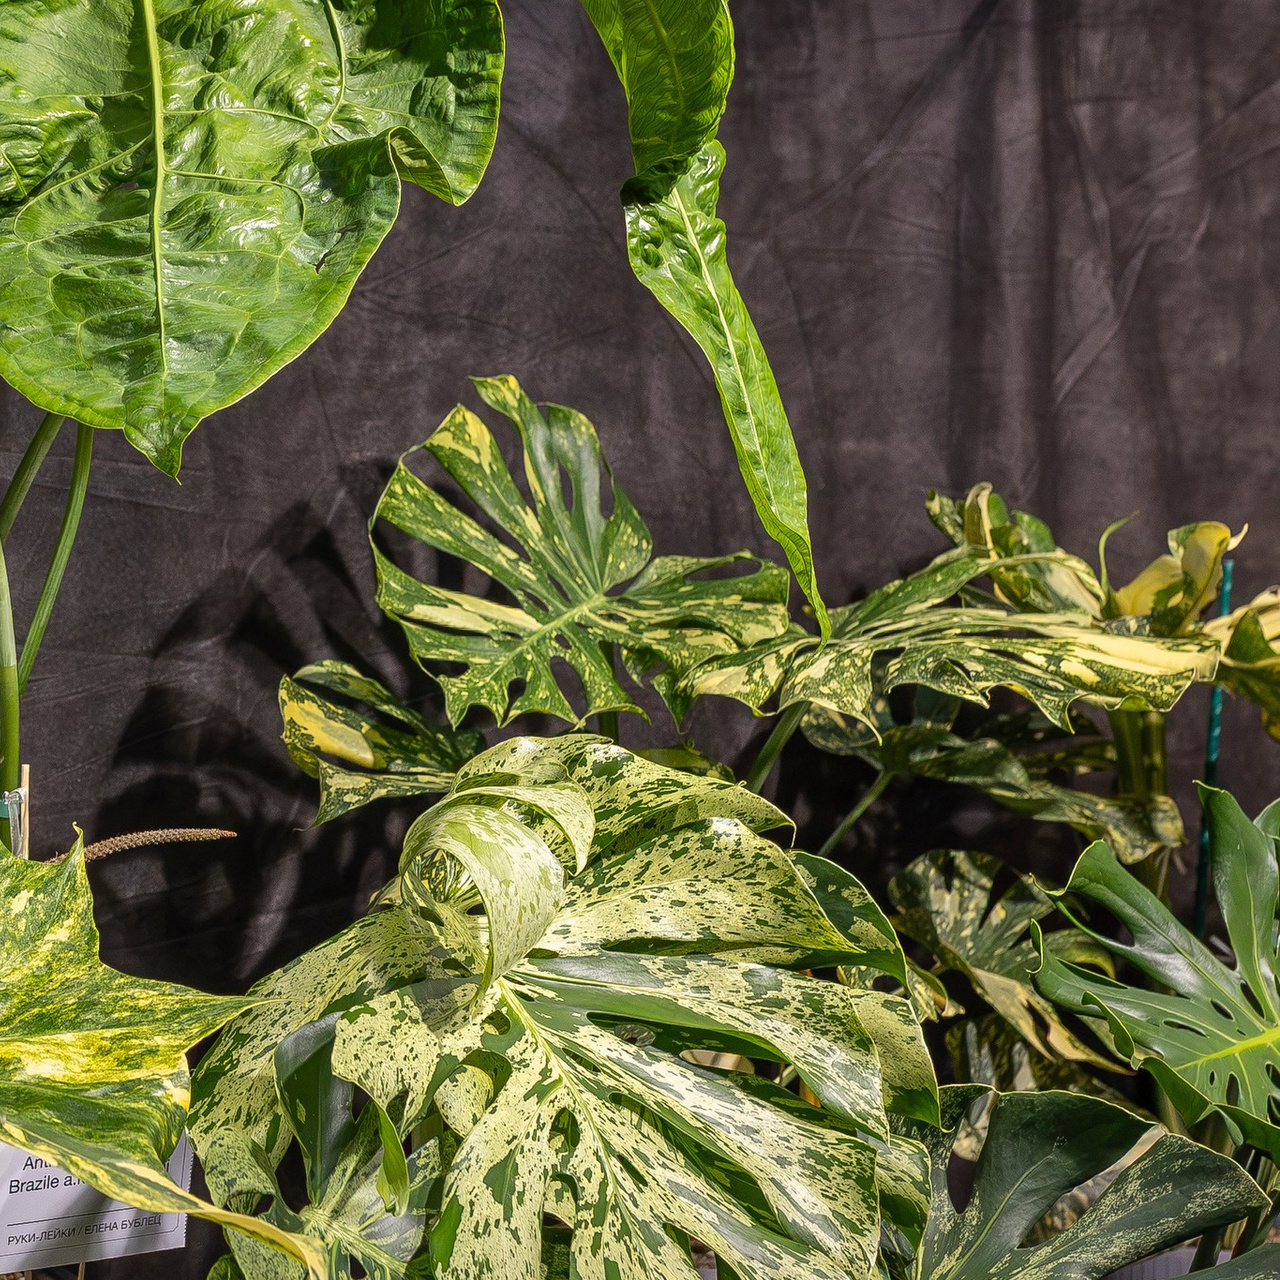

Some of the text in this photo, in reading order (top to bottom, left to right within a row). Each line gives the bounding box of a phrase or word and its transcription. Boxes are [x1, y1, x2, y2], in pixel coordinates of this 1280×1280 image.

[9, 1175, 59, 1194] Brazile
[7, 1227, 76, 1246] РУКИ-ЛЕЙКИ
[85, 1221, 119, 1235] ЕЛЕНА
[121, 1215, 162, 1231] БУБЛЕЦ
